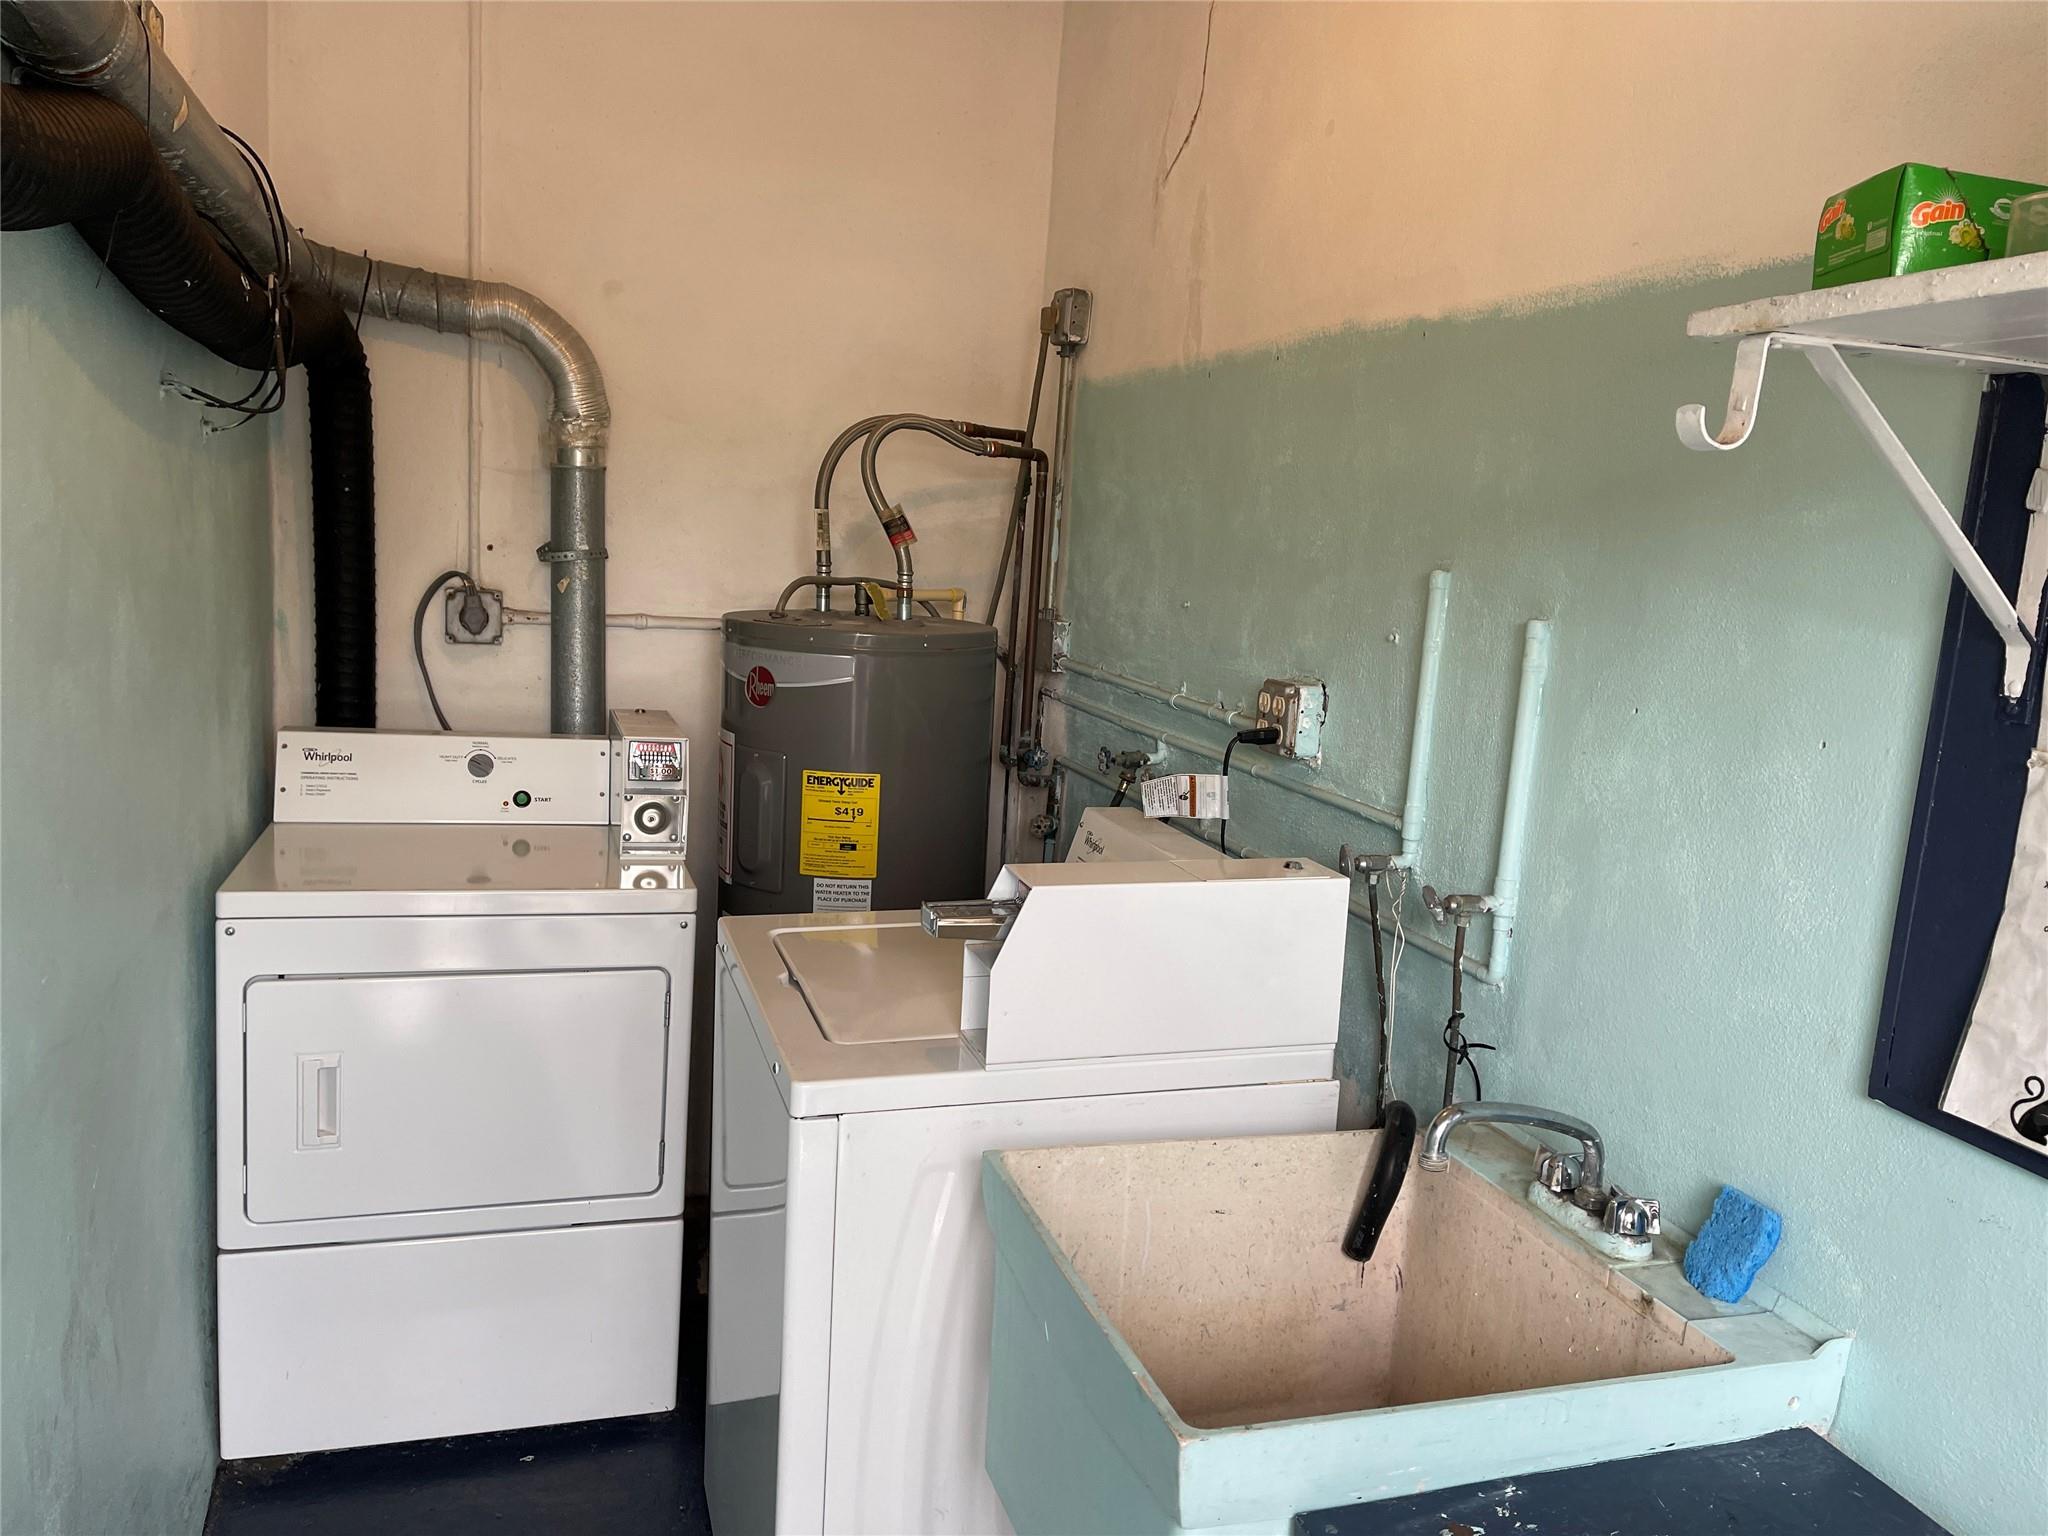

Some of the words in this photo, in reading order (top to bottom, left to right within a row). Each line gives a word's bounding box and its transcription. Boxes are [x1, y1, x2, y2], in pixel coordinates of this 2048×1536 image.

[1818, 199, 1846, 233] Gain
[1911, 200, 1965, 228] Gain
[747, 666, 775, 701] Rheem
[303, 751, 353, 764] Whirlpool
[806, 775, 875, 789] ENERGYGUIDE
[834, 806, 864, 817] $419
